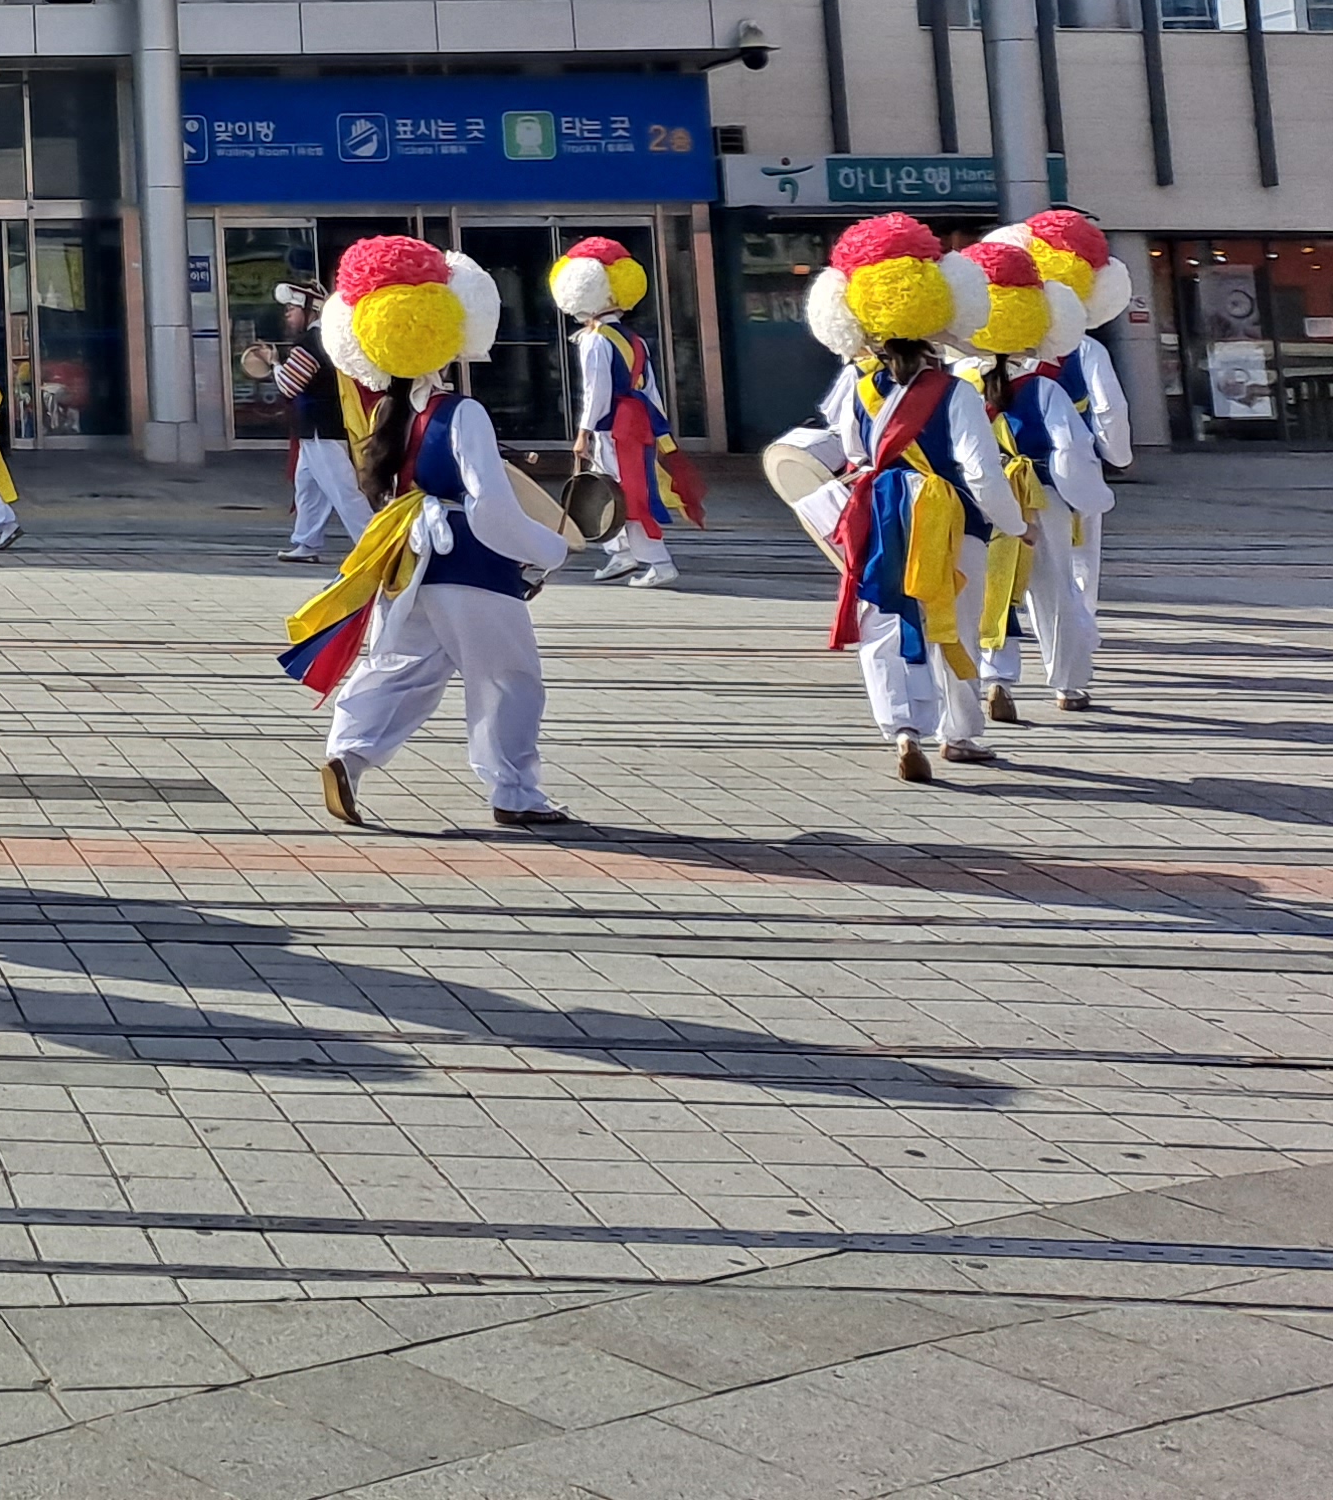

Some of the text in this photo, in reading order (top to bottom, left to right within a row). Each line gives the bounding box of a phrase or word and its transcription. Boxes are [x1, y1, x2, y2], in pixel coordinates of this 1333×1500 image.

[213, 120, 276, 142] 맞이방
[395, 118, 486, 139] 표사는 곳
[561, 116, 630, 137] 타는 곳
[258, 147, 289, 156] Room
[837, 165, 952, 195] 하나은행
